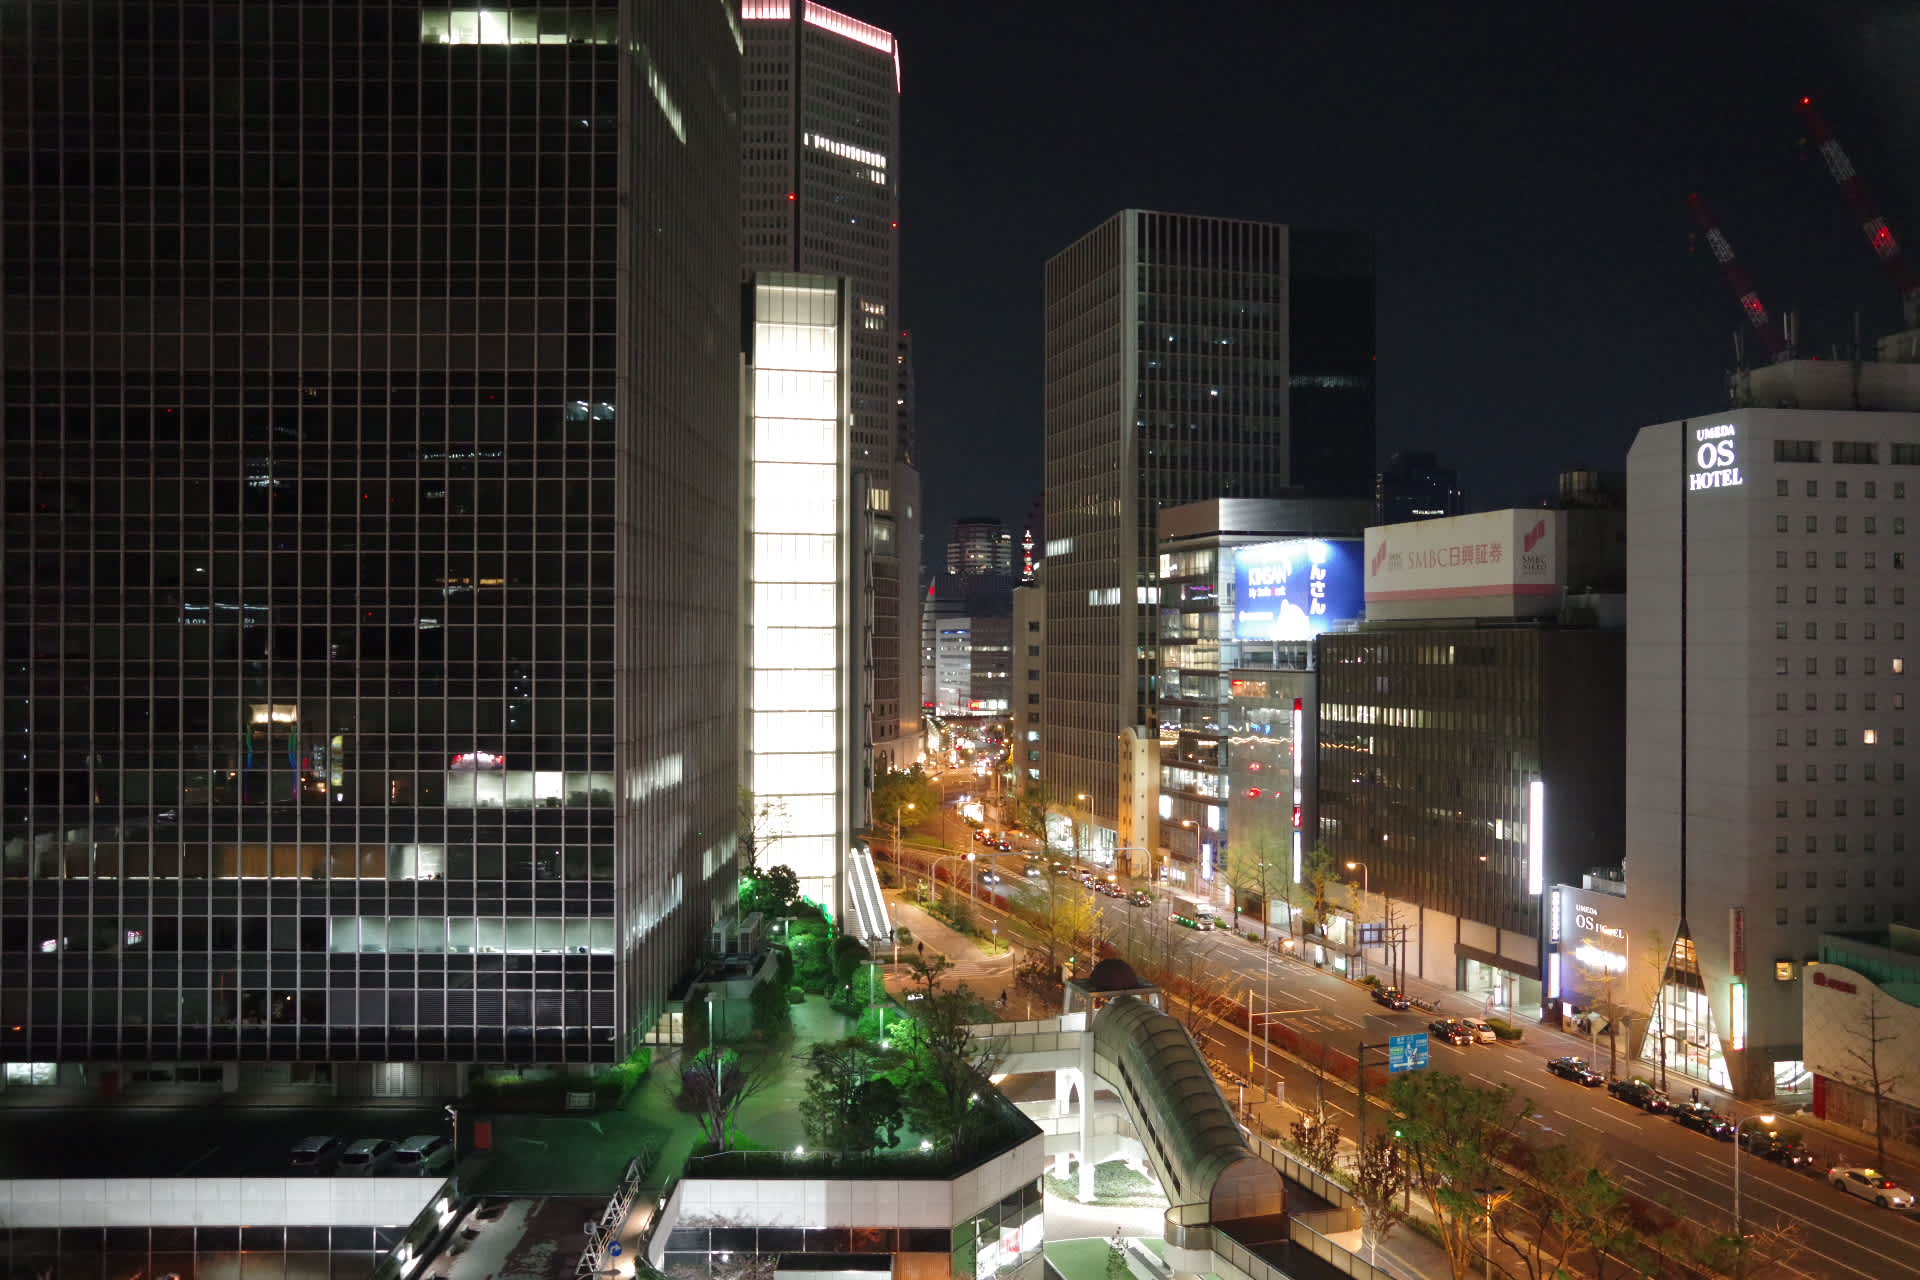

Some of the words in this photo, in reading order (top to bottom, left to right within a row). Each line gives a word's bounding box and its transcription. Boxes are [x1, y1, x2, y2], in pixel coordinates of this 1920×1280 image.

[1696, 424, 1735, 441] UMEDA
[1697, 440, 1735, 469] OS
[1690, 467, 1743, 491] HOTEL
[1407, 544, 1504, 570] SMBC日興証券
[1309, 543, 1327, 616] んさん
[1576, 904, 1598, 915] UMEDA
[1576, 914, 1594, 930] OS
